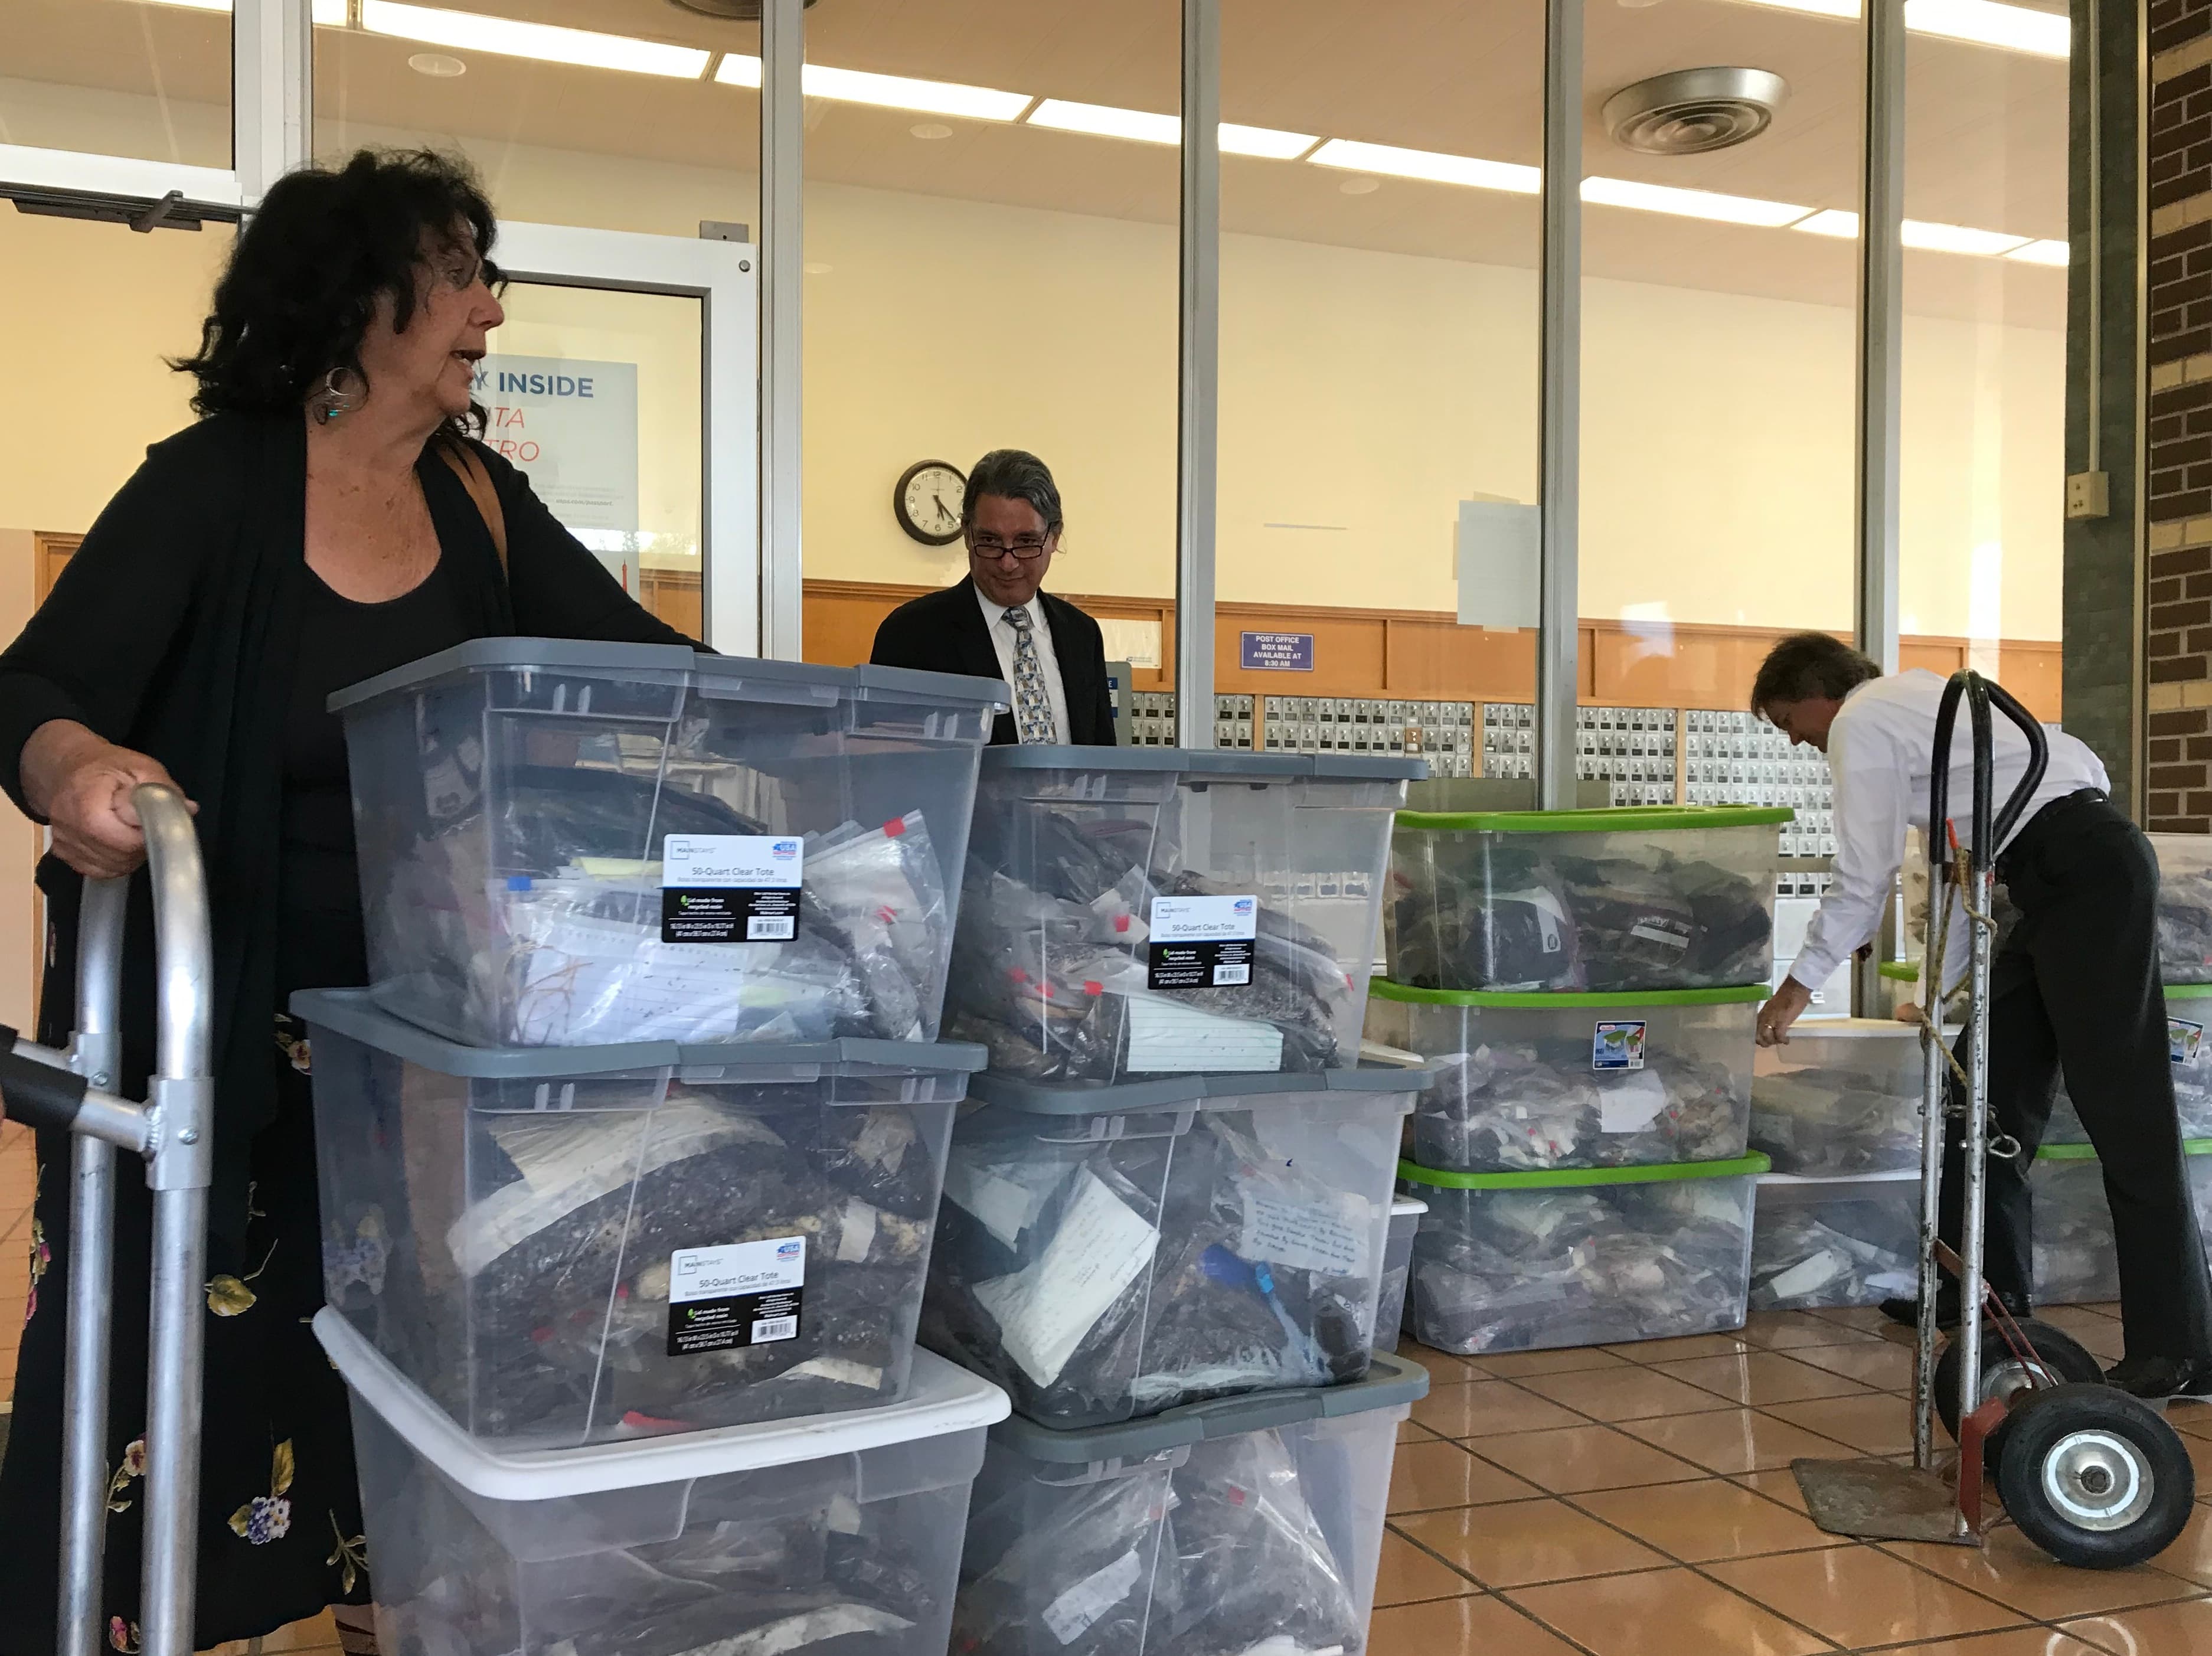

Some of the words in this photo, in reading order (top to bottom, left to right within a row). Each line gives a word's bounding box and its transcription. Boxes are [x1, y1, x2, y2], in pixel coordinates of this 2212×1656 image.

[499, 372, 593, 398] INSIDE
[692, 867, 730, 876] 50-Quart
[732, 867, 753, 876] Clear
[699, 1277, 736, 1288] 50-Quart
[738, 1275, 759, 1283] Clear
[760, 1272, 779, 1280] Tote
